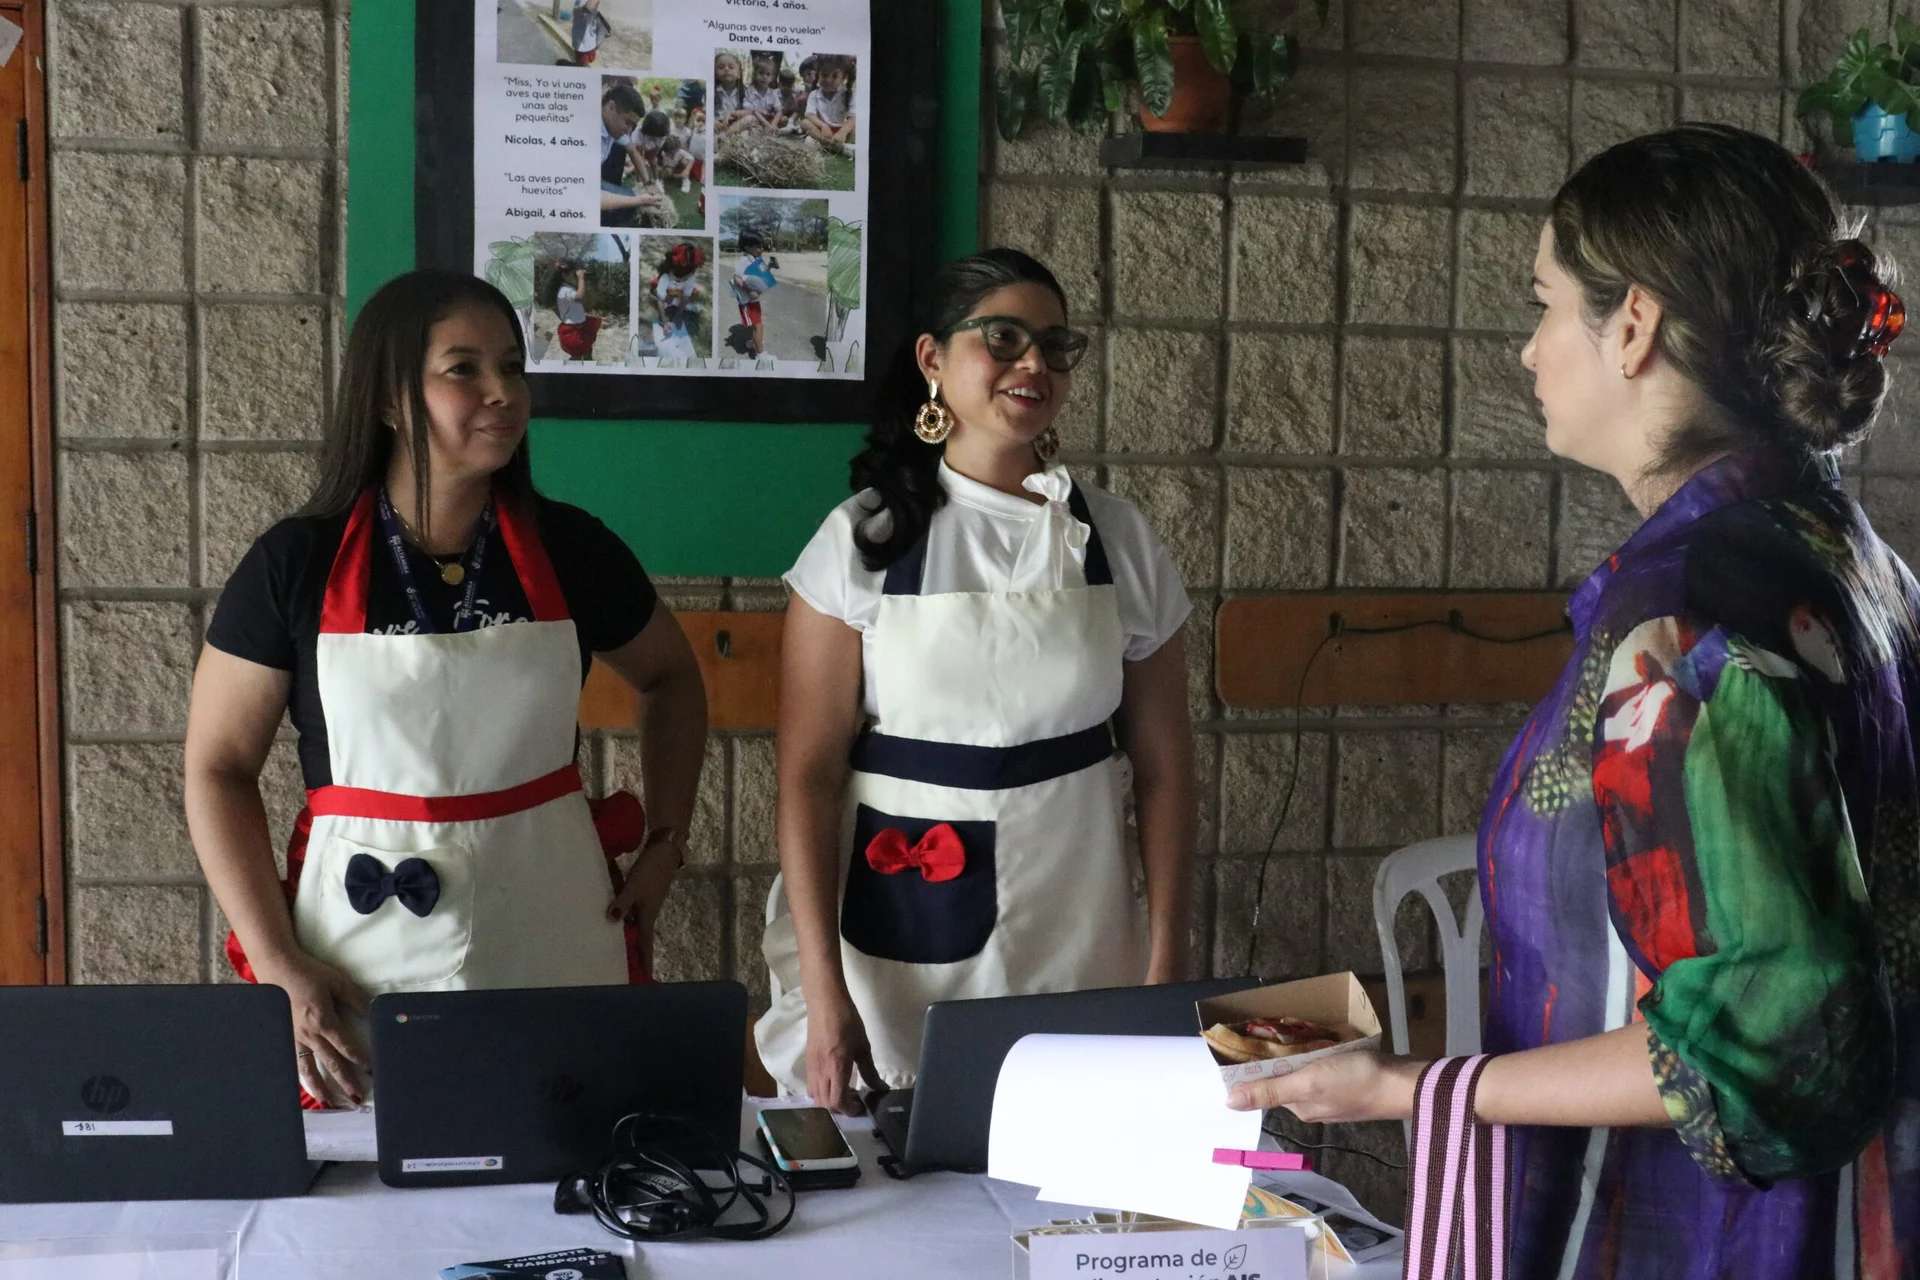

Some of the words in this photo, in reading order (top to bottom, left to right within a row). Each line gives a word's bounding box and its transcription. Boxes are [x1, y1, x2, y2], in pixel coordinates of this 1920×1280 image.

[773, 0, 780, 8] 4
[782, 0, 809, 10] años.
[703, 20, 747, 31] "Algunas
[750, 24, 772, 32] aves
[790, 26, 825, 35] vuelan"
[729, 32, 763, 44] Dante,
[766, 35, 773, 43] 4
[776, 36, 803, 45] años.
[503, 76, 532, 88] "Miss,
[536, 78, 549, 87] Yo
[551, 79, 561, 88] vi
[505, 90, 529, 98] aves
[532, 91, 551, 100] que
[554, 91, 584, 100] tienen
[522, 102, 545, 110] unas
[548, 102, 568, 111] alas
[515, 113, 574, 123] pequeñitas"
[505, 134, 546, 146] Nicolas,
[550, 136, 557, 145] 4
[560, 137, 587, 147] años.
[504, 172, 526, 182] "Las
[528, 175, 552, 183] aves
[554, 176, 585, 185] ponen
[521, 185, 567, 195] huevitos"
[505, 207, 545, 219] Abigail,
[549, 209, 556, 217] 4
[559, 209, 587, 219] años.
[503, 1254, 607, 1268] TRANSPORTE
[1076, 1251, 1184, 1273] Programa
[1191, 1248, 1218, 1266] de
